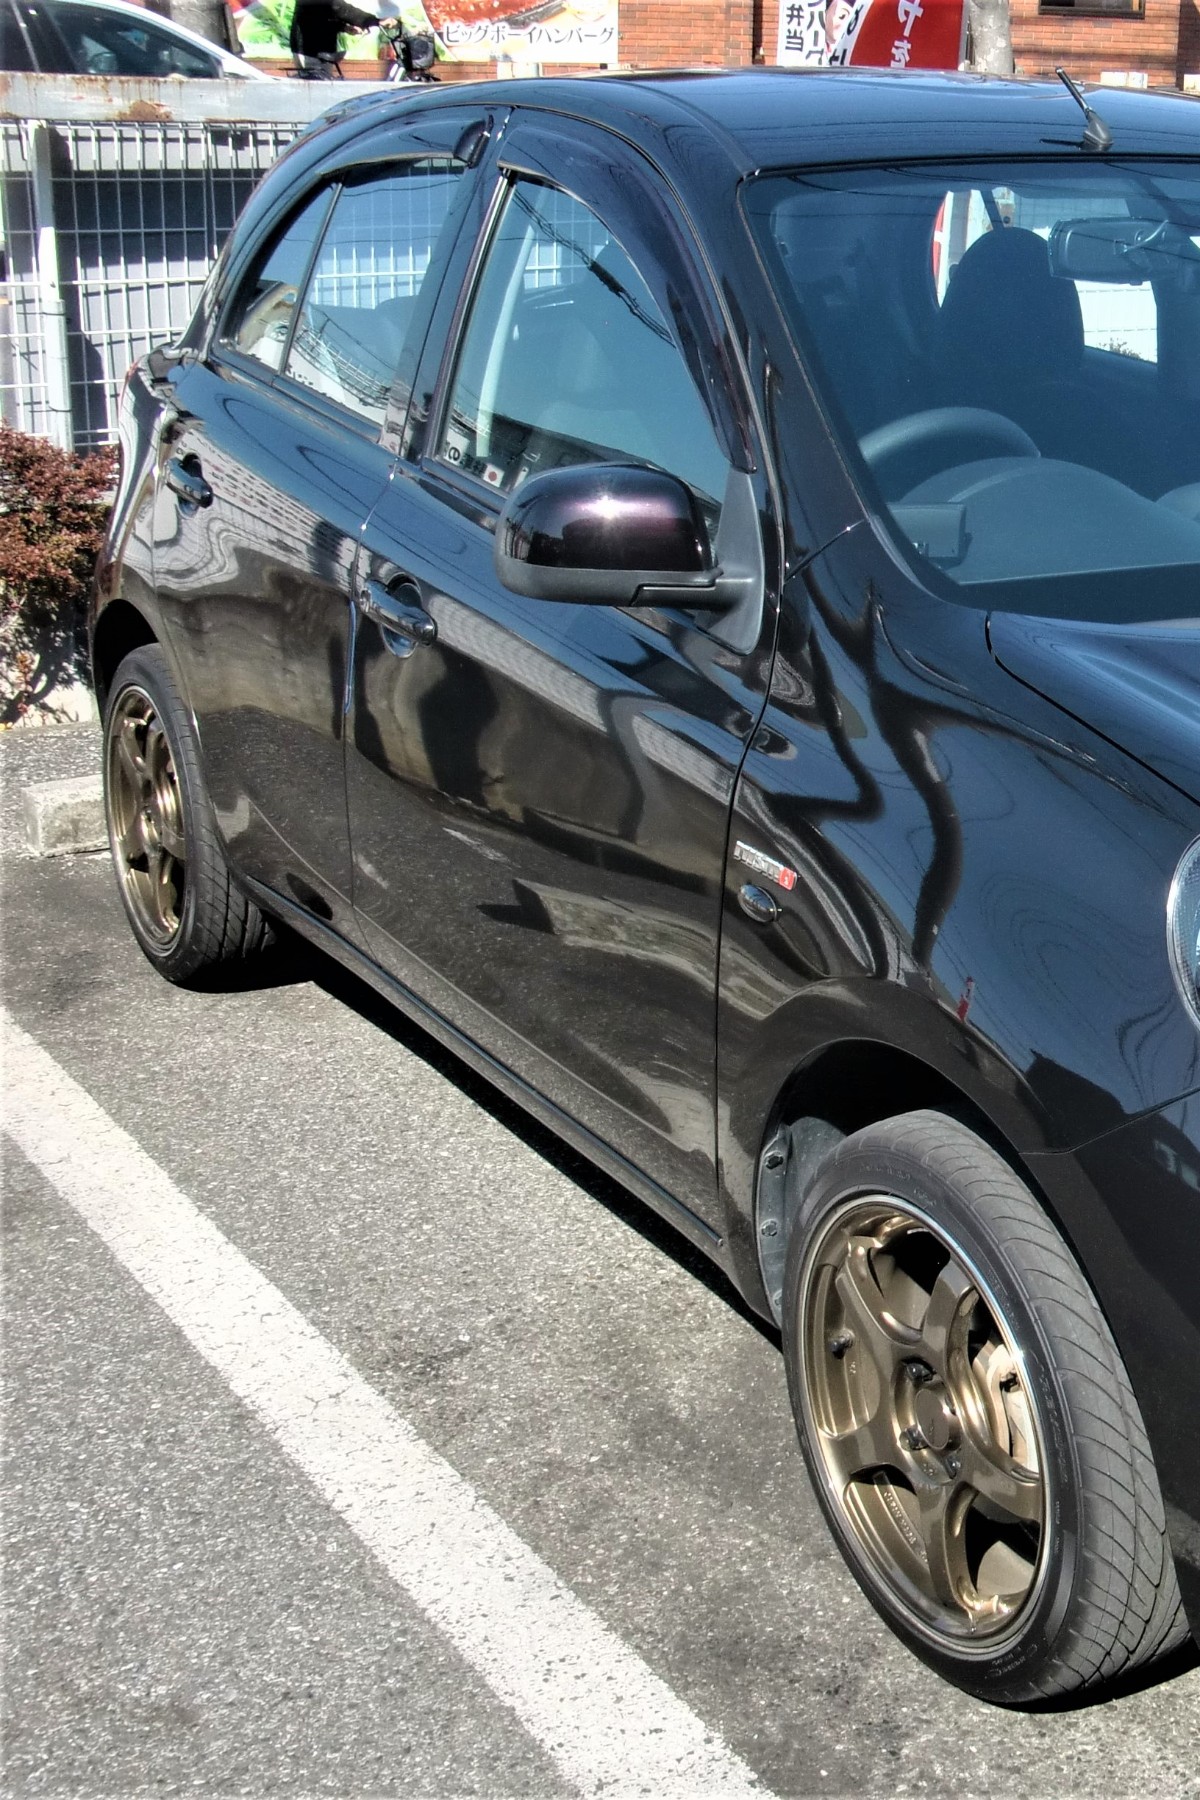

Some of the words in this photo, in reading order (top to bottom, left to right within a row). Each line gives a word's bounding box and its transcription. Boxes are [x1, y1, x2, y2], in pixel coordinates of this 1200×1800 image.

[445, 25, 615, 44] ビッグボーイハンバーグ
[785, 3, 805, 52] 弁当
